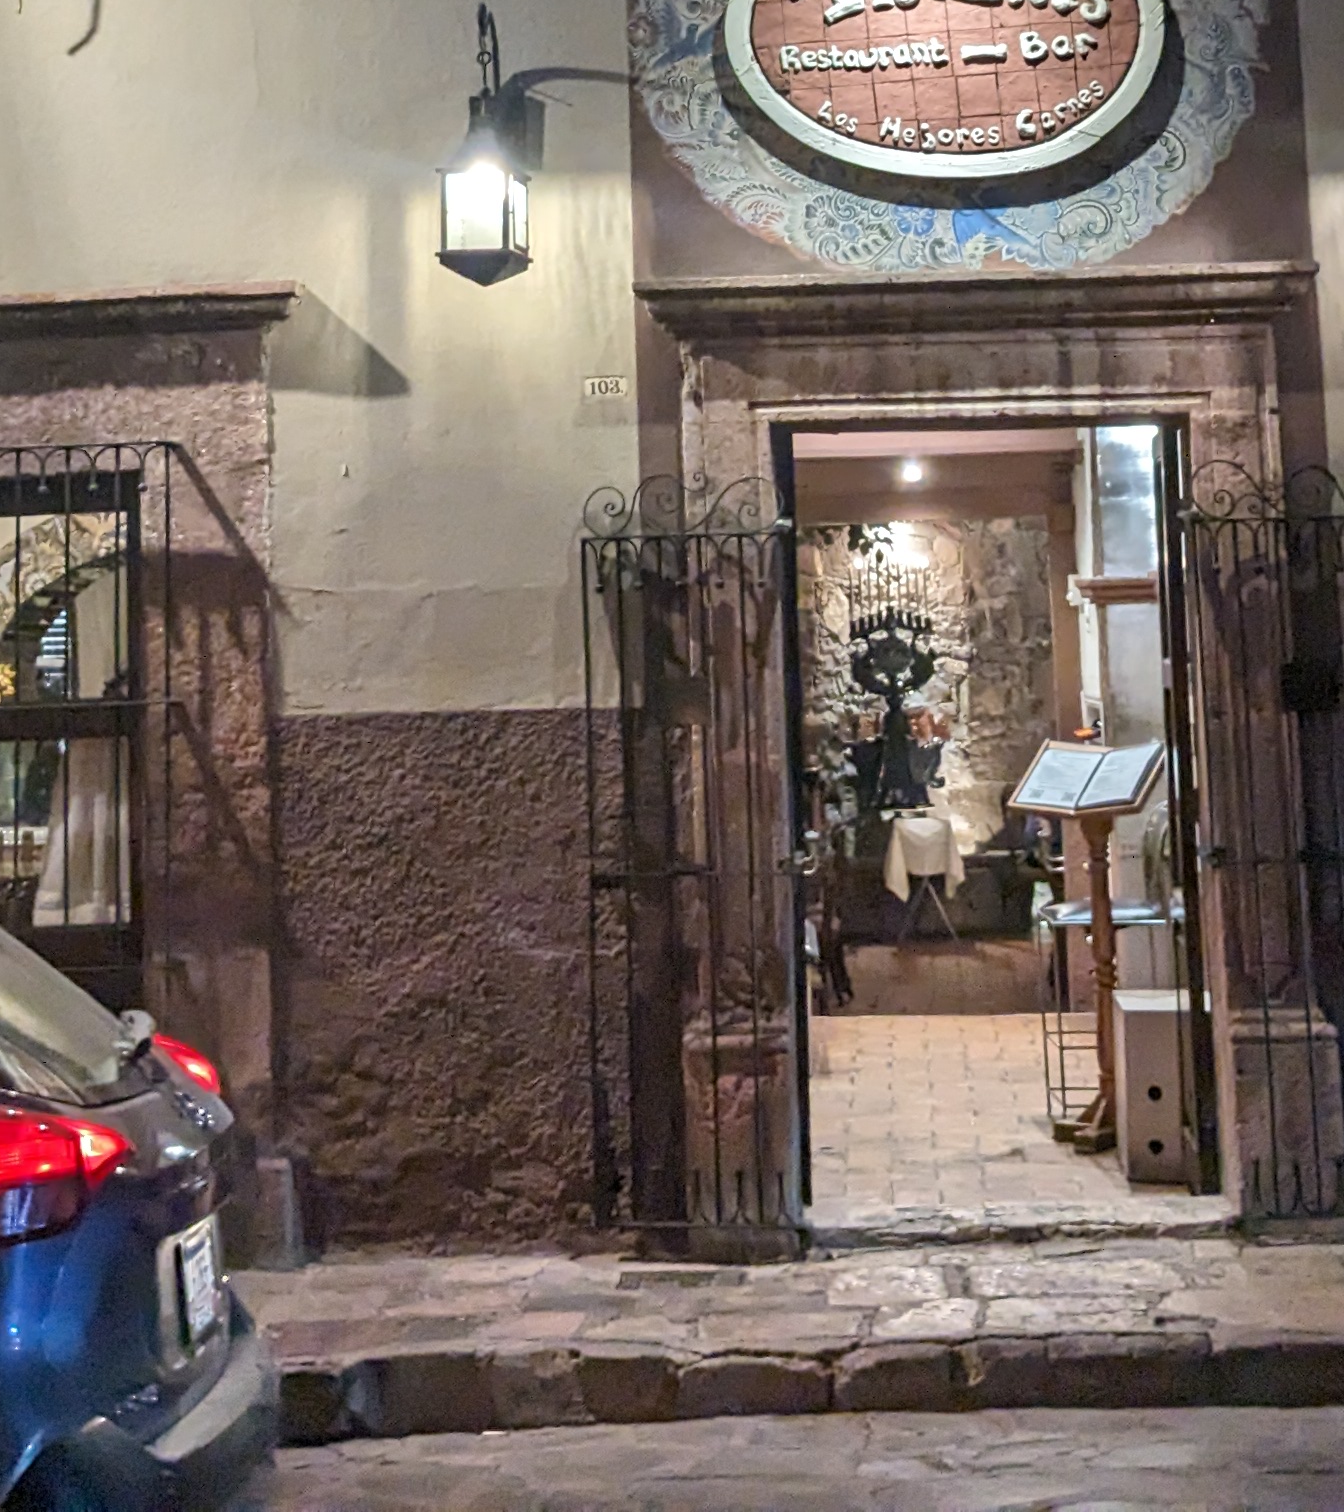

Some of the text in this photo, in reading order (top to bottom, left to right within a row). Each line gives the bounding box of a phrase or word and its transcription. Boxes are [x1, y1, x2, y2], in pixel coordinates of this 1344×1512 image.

[780, 37, 949, 71] Restaurant
[1020, 31, 1097, 61] Bar
[879, 116, 1001, 151] Mejores
[1016, 80, 1105, 136] Carnes
